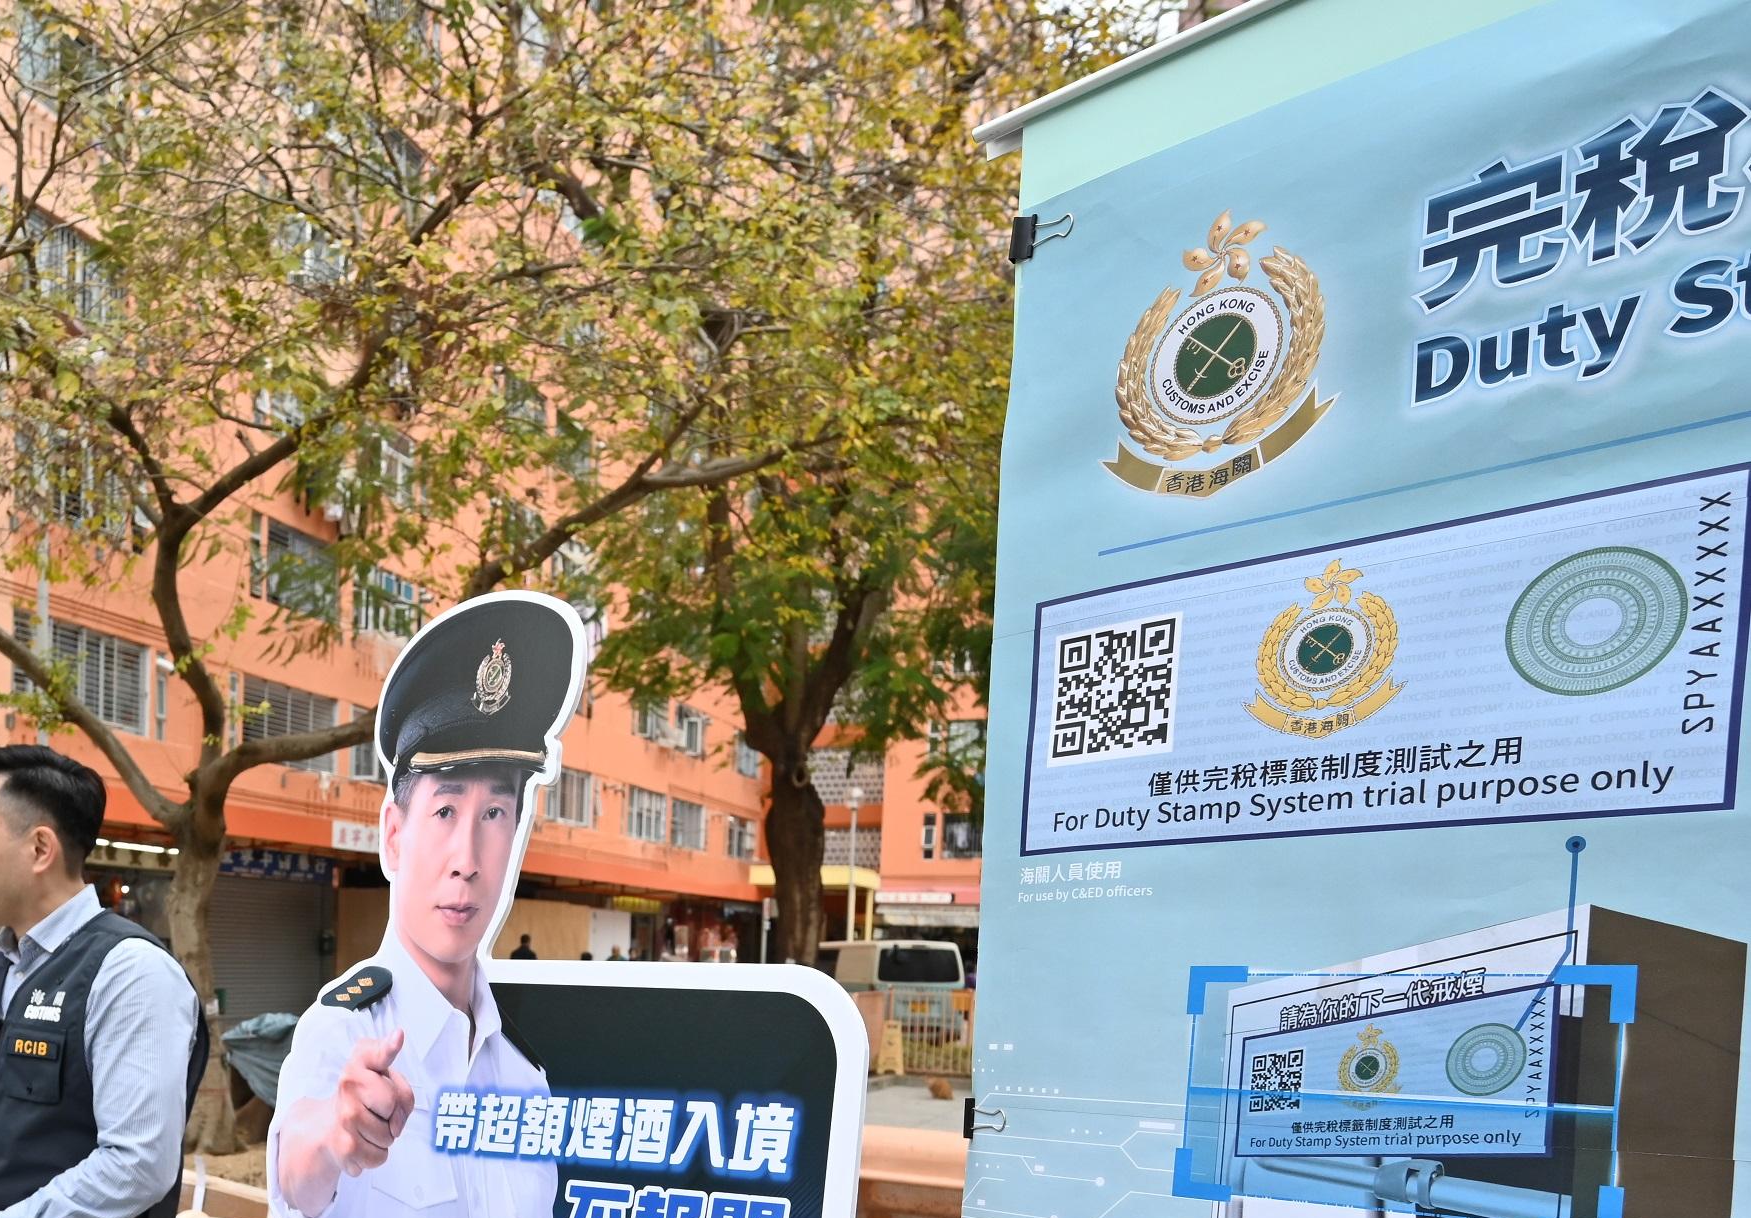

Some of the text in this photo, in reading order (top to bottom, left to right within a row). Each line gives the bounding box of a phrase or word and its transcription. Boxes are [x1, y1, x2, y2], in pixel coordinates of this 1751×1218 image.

[1421, 86, 1751, 313] 完稅
[1178, 298, 1256, 335] HONG KONG
[1411, 291, 1646, 407] Duty
[1162, 350, 1269, 414] CUSTOMS AND EXCISE
[1165, 453, 1251, 494] 香港海關
[1300, 615, 1354, 633] HONG KONG
[1682, 492, 1731, 735] SPYAAXXXXX
[1289, 649, 1362, 685] CUSTOMS AND EXCISE
[1148, 736, 1523, 798] 僅供完稅標籤制度測試之用
[1053, 761, 1674, 832] For Duty Stamp System trial purpose only
[1018, 885, 1153, 903] For use by C&ED officers
[1020, 861, 1122, 885] 海關人員使用
[1280, 967, 1486, 1032] 請為你的下一代戒煙
[15, 1039, 48, 1056] RCIB
[435, 1091, 795, 1174] 帶超額煙酒入境
[1250, 1129, 1521, 1150] For Duty Stamp System trial purpose only
